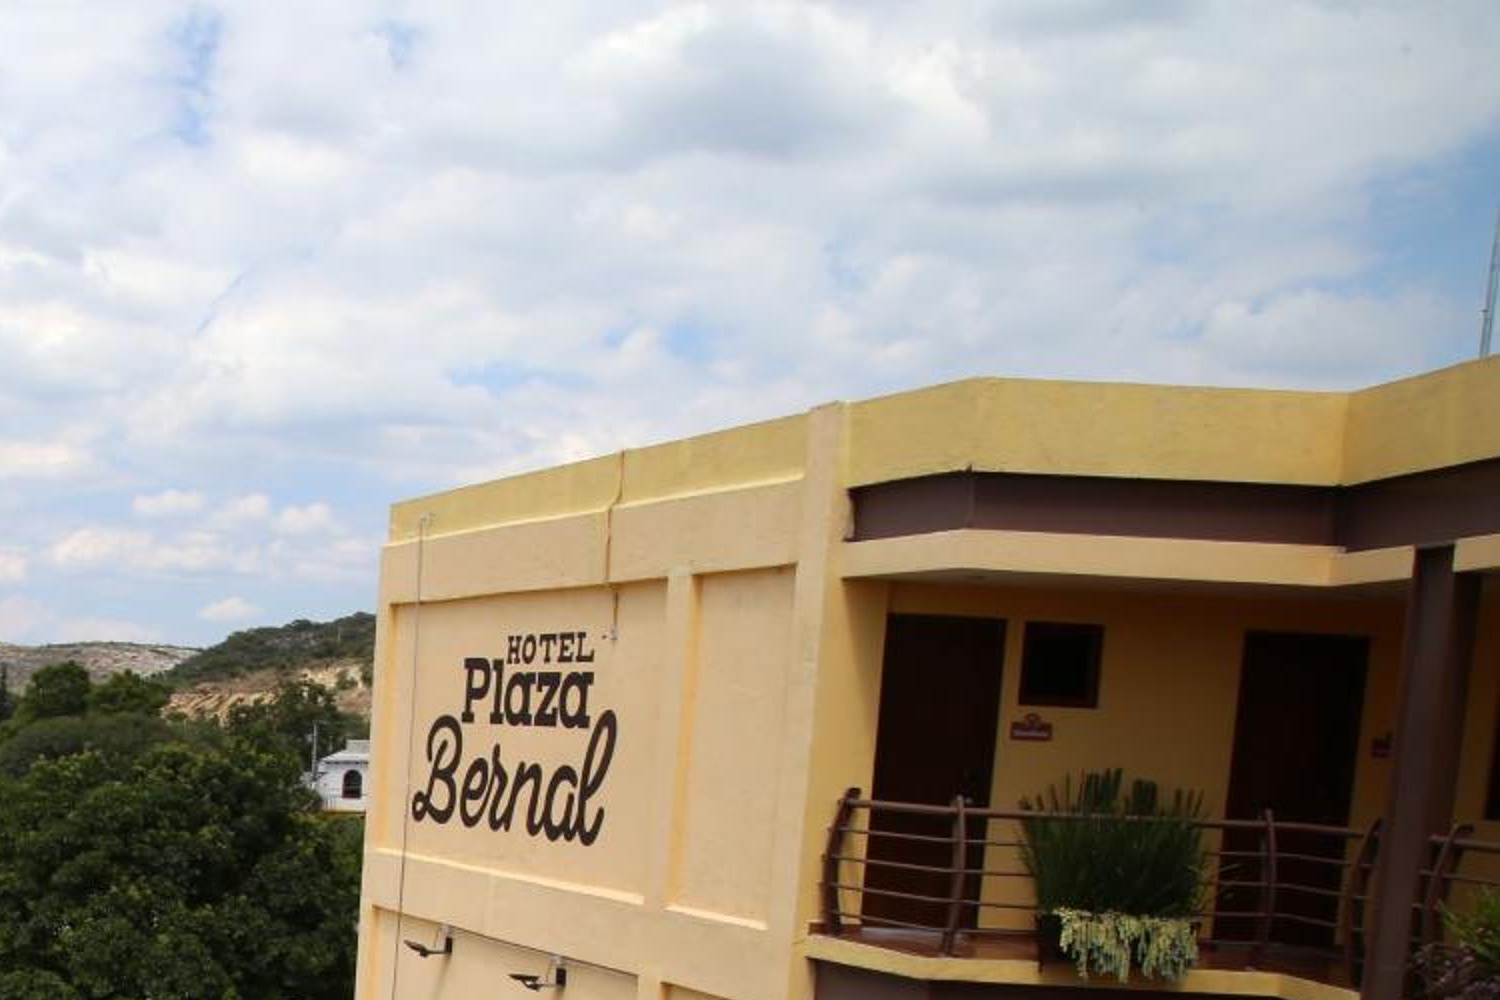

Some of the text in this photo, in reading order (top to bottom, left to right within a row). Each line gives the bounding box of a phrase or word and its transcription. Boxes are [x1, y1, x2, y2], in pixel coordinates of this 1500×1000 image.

[506, 631, 595, 665] HOTEL
[461, 657, 595, 729] Plaza
[411, 709, 617, 847] Bernal
